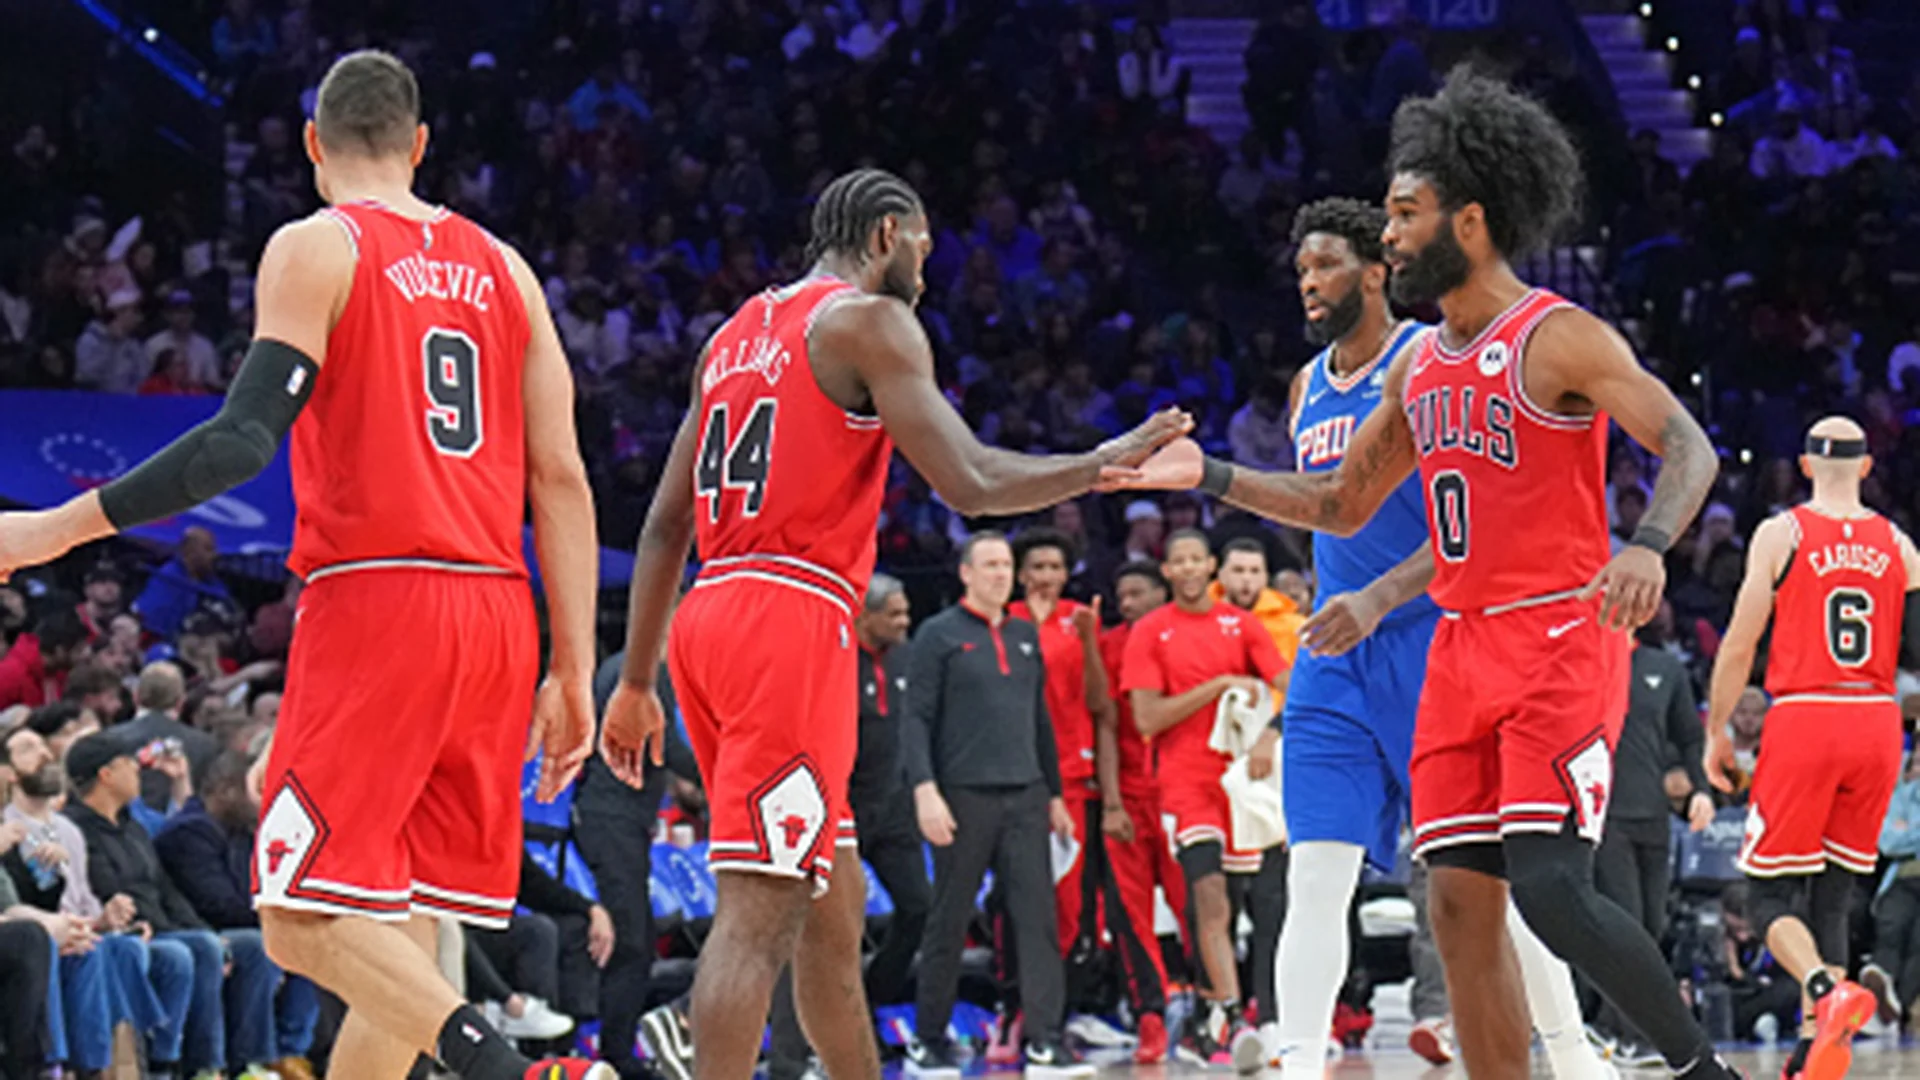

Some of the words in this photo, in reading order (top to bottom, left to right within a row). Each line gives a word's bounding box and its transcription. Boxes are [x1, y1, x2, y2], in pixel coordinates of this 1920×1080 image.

[421, 326, 483, 459] 9
[694, 397, 777, 524] 44
[1430, 468, 1470, 564] 0
[1825, 586, 1874, 668] 6
